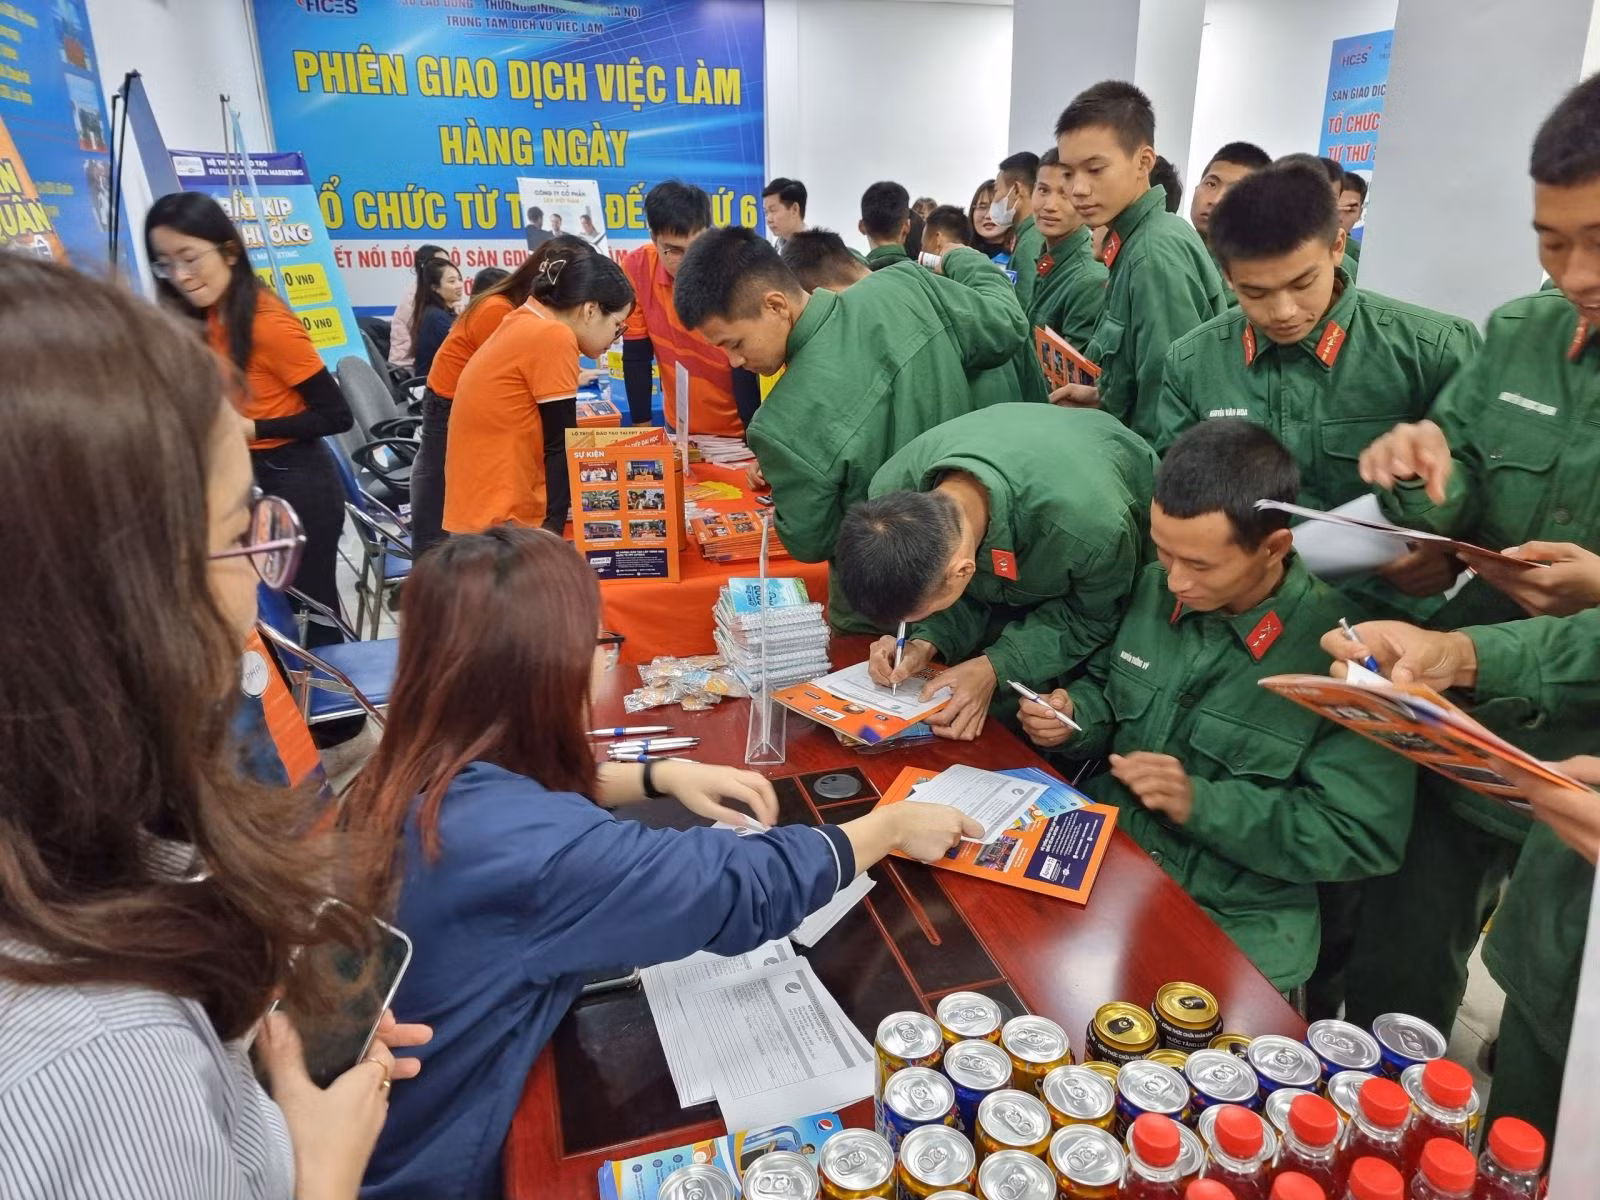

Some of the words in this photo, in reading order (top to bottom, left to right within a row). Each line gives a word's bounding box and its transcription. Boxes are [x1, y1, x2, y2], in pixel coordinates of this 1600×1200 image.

[447, 16, 482, 27] TRUNG
[293, 44, 408, 95] PHIÊN
[416, 55, 499, 98] GIAO
[507, 59, 587, 109] DỊCH
[595, 56, 667, 112] VIỆC
[675, 58, 741, 106] LÀM
[1350, 86, 1370, 99] GIAO
[438, 117, 535, 167] HÀNG
[542, 120, 629, 168] NGÀY
[0, 195, 52, 237] UÂN
[319, 176, 345, 230] Ổ
[353, 183, 448, 230] CHỨC
[454, 183, 500, 230] TỪ
[605, 182, 650, 230] ĐẾ
[740, 195, 758, 229] 6
[334, 244, 353, 268] ẾT
[357, 244, 387, 268] NỐI
[466, 246, 498, 267] SÀN
[295, 274, 315, 285] VNĐ
[313, 318, 333, 330] VNĐ
[573, 450, 585, 459] SỰ
[586, 449, 605, 458] KIỆN
